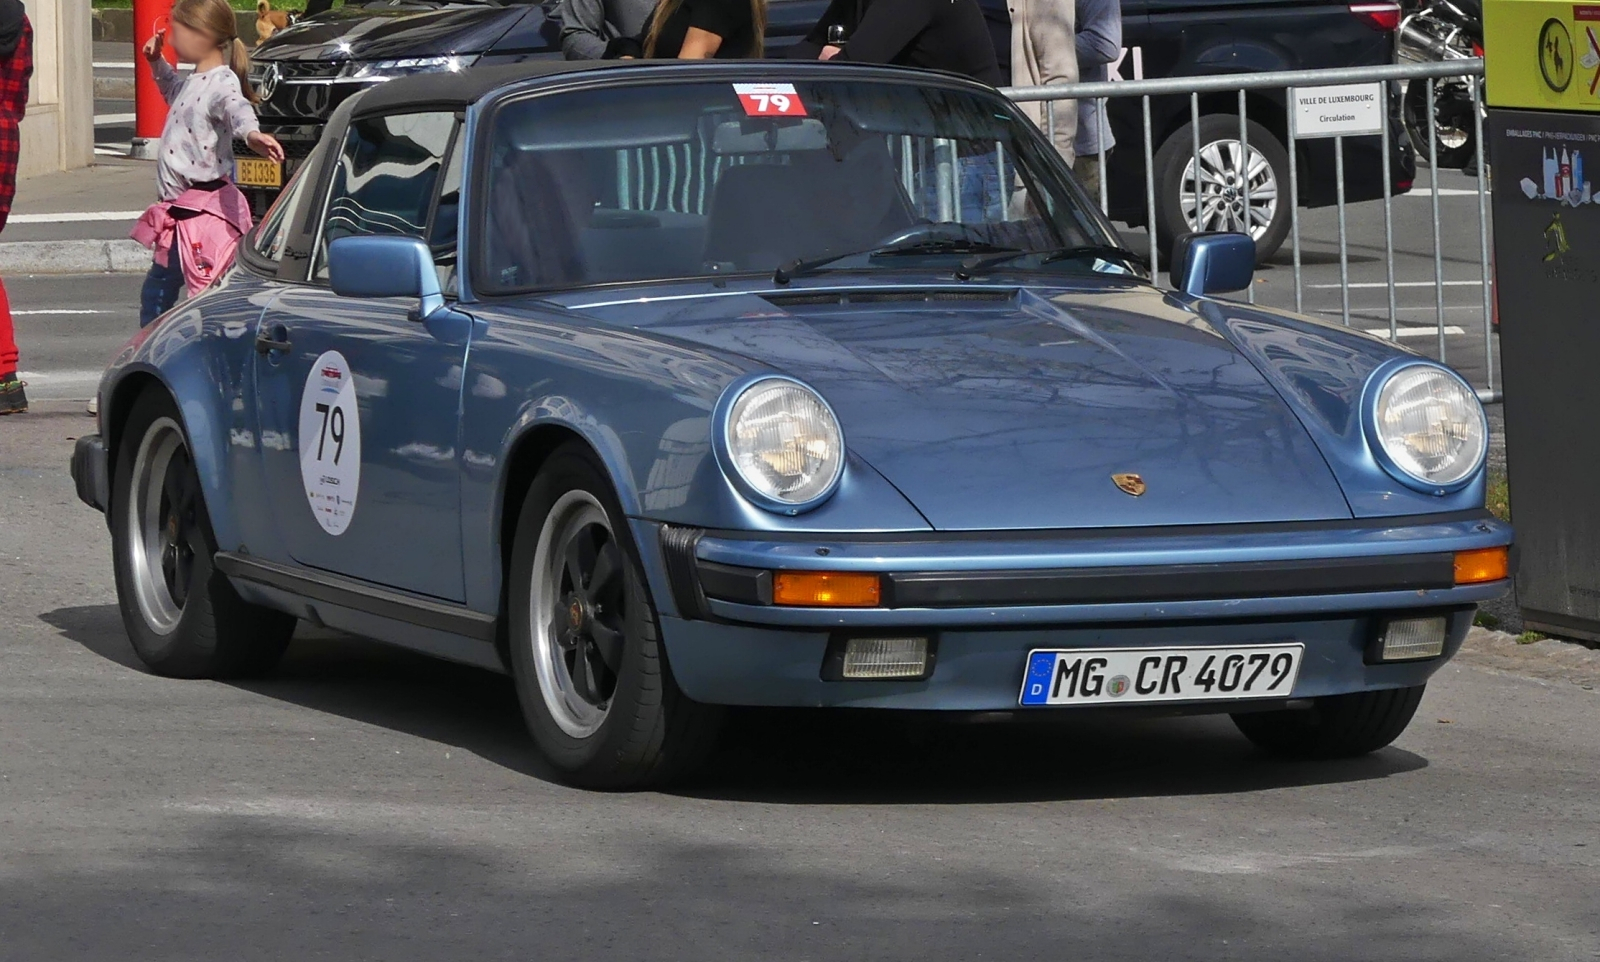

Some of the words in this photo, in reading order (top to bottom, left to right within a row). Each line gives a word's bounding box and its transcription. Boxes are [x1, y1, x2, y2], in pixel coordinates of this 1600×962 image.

[749, 94, 790, 113] 79
[1299, 97, 1317, 105] VILLE
[1318, 96, 1327, 104] DE
[1328, 93, 1374, 104] LUXEMBOURG
[1319, 113, 1356, 123] Circulation
[315, 402, 345, 466] 79
[1052, 658, 1108, 698] MG
[1134, 655, 1188, 695] CR
[1194, 652, 1293, 693] 4079
[1031, 683, 1043, 696] D
